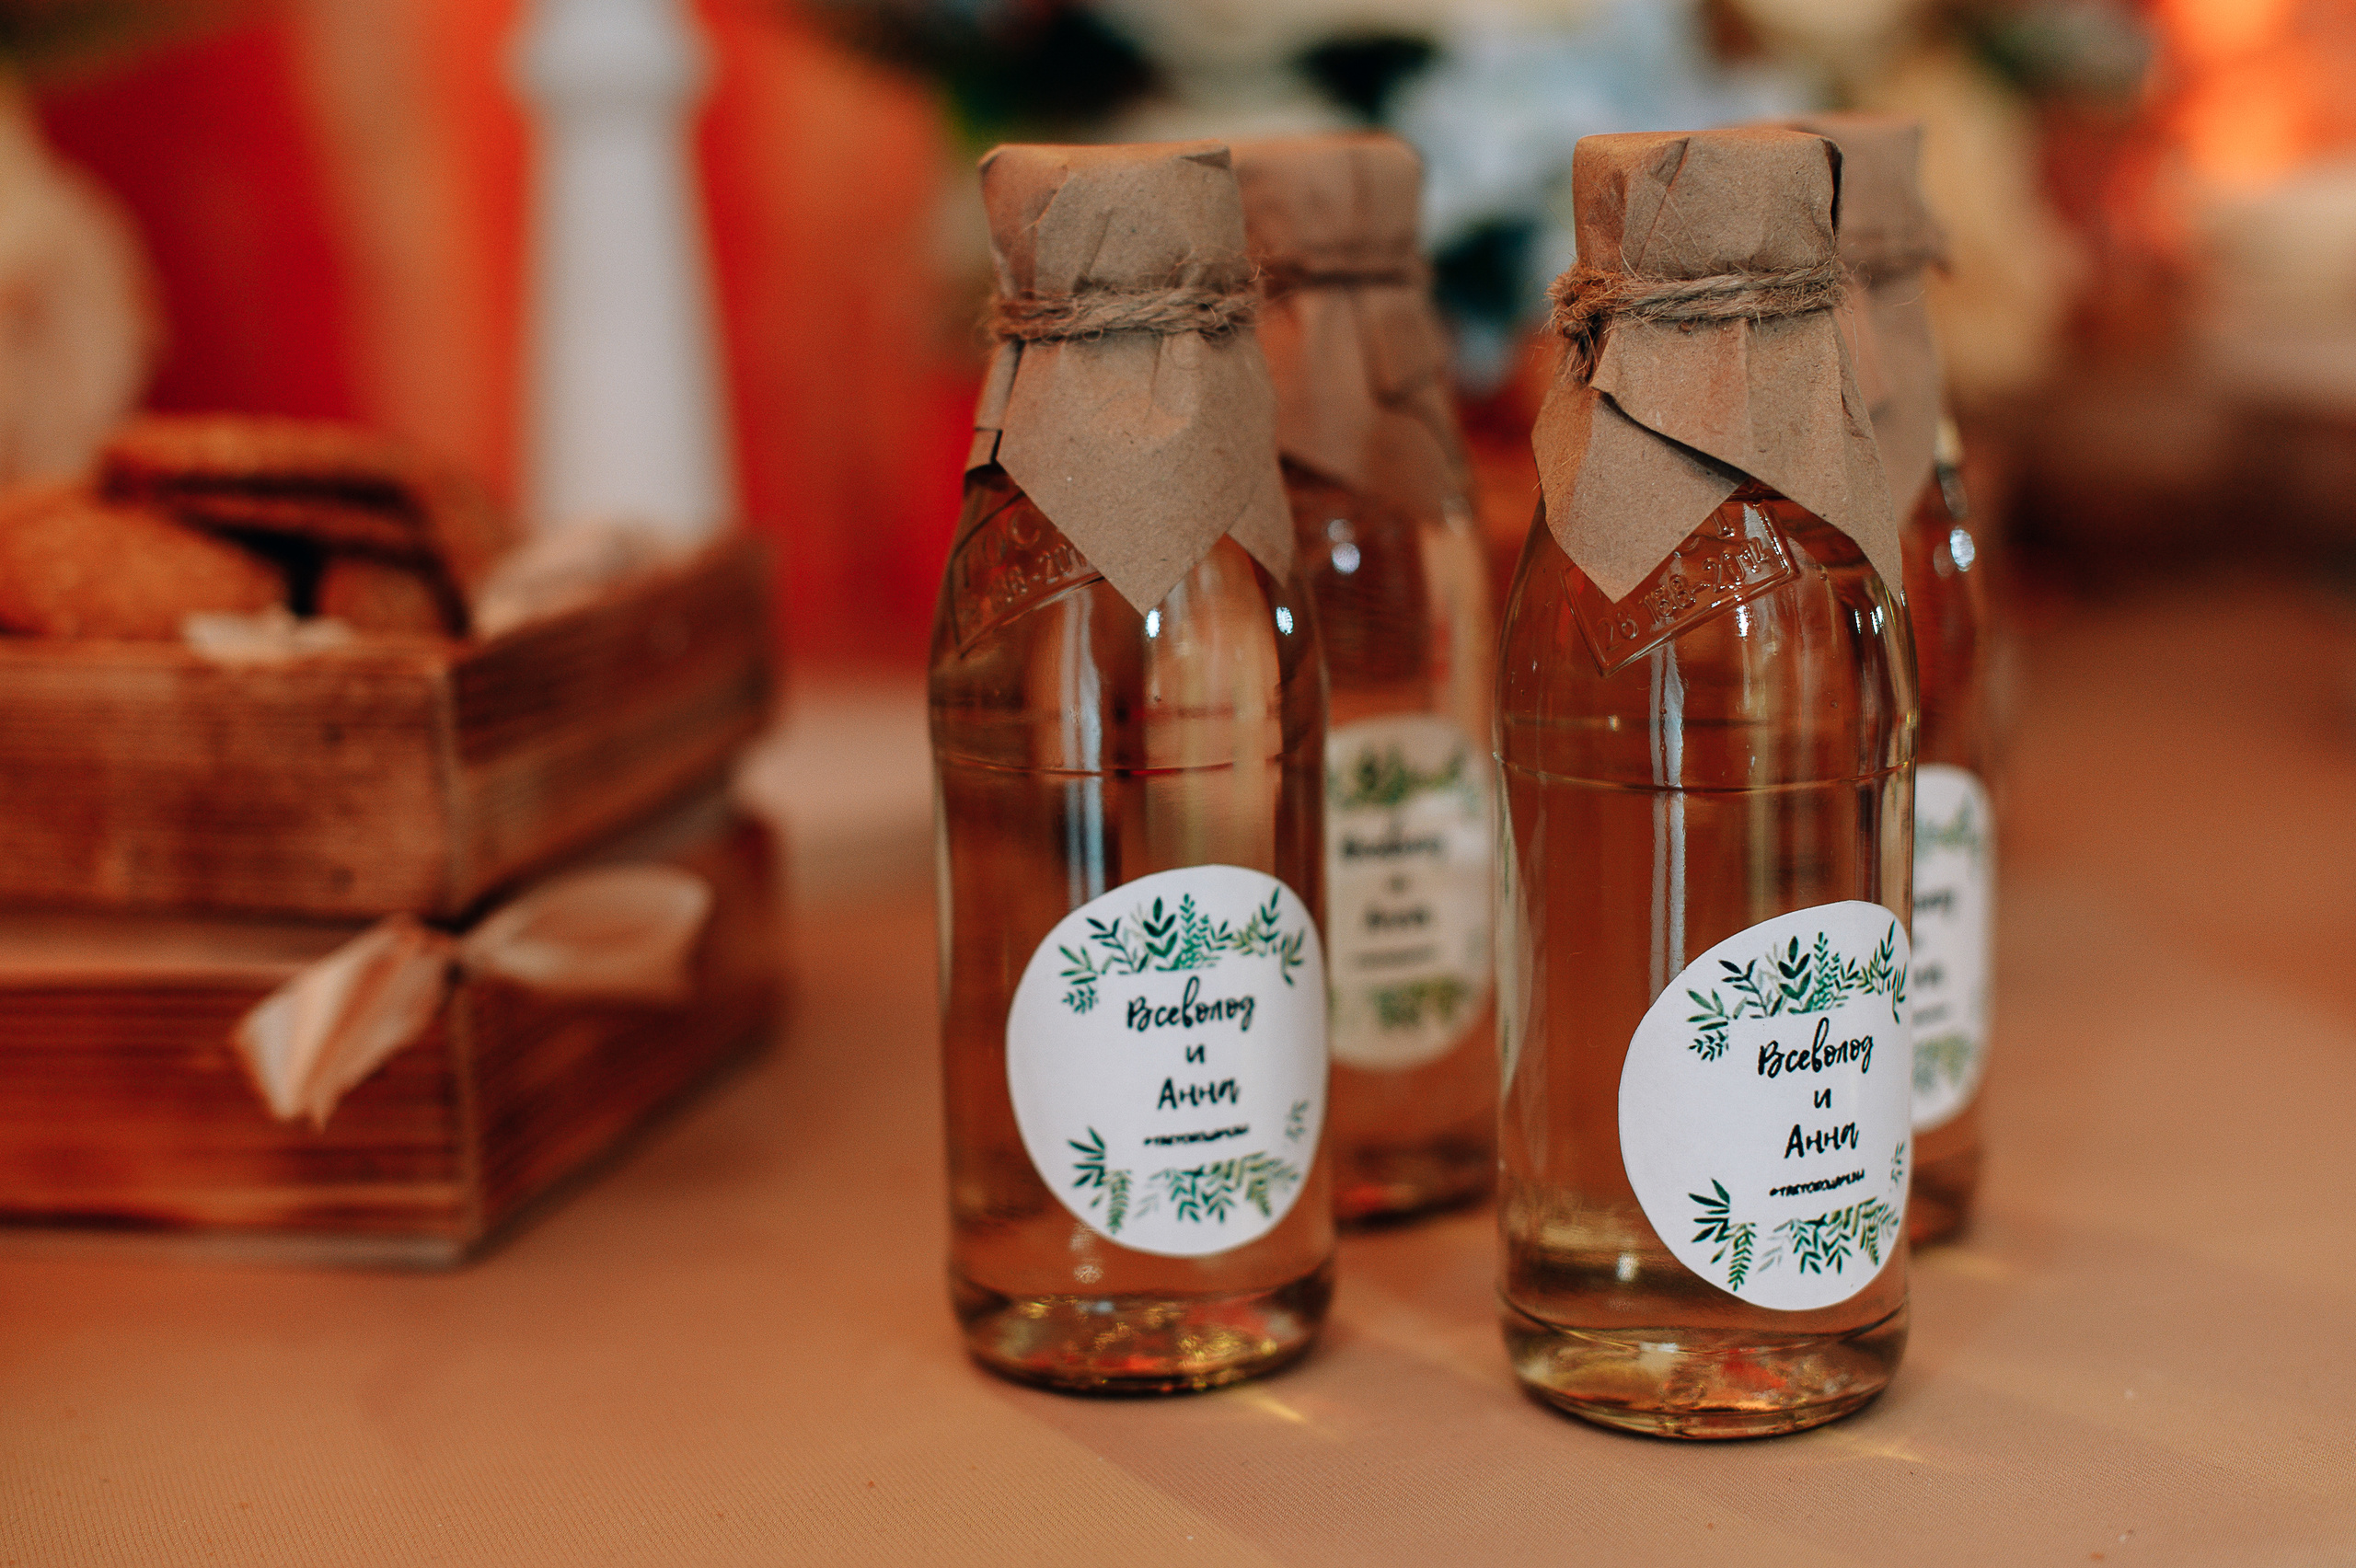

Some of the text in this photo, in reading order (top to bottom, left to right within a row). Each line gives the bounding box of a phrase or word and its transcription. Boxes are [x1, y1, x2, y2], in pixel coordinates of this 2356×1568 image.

[1127, 975, 1255, 1032] Всеволод
[1185, 1043, 1206, 1065] и
[1758, 1016, 1874, 1079] Всеволод
[1157, 1078, 1240, 1110] Анна
[1812, 1088, 1832, 1110] и
[1784, 1121, 1860, 1159] Анна
